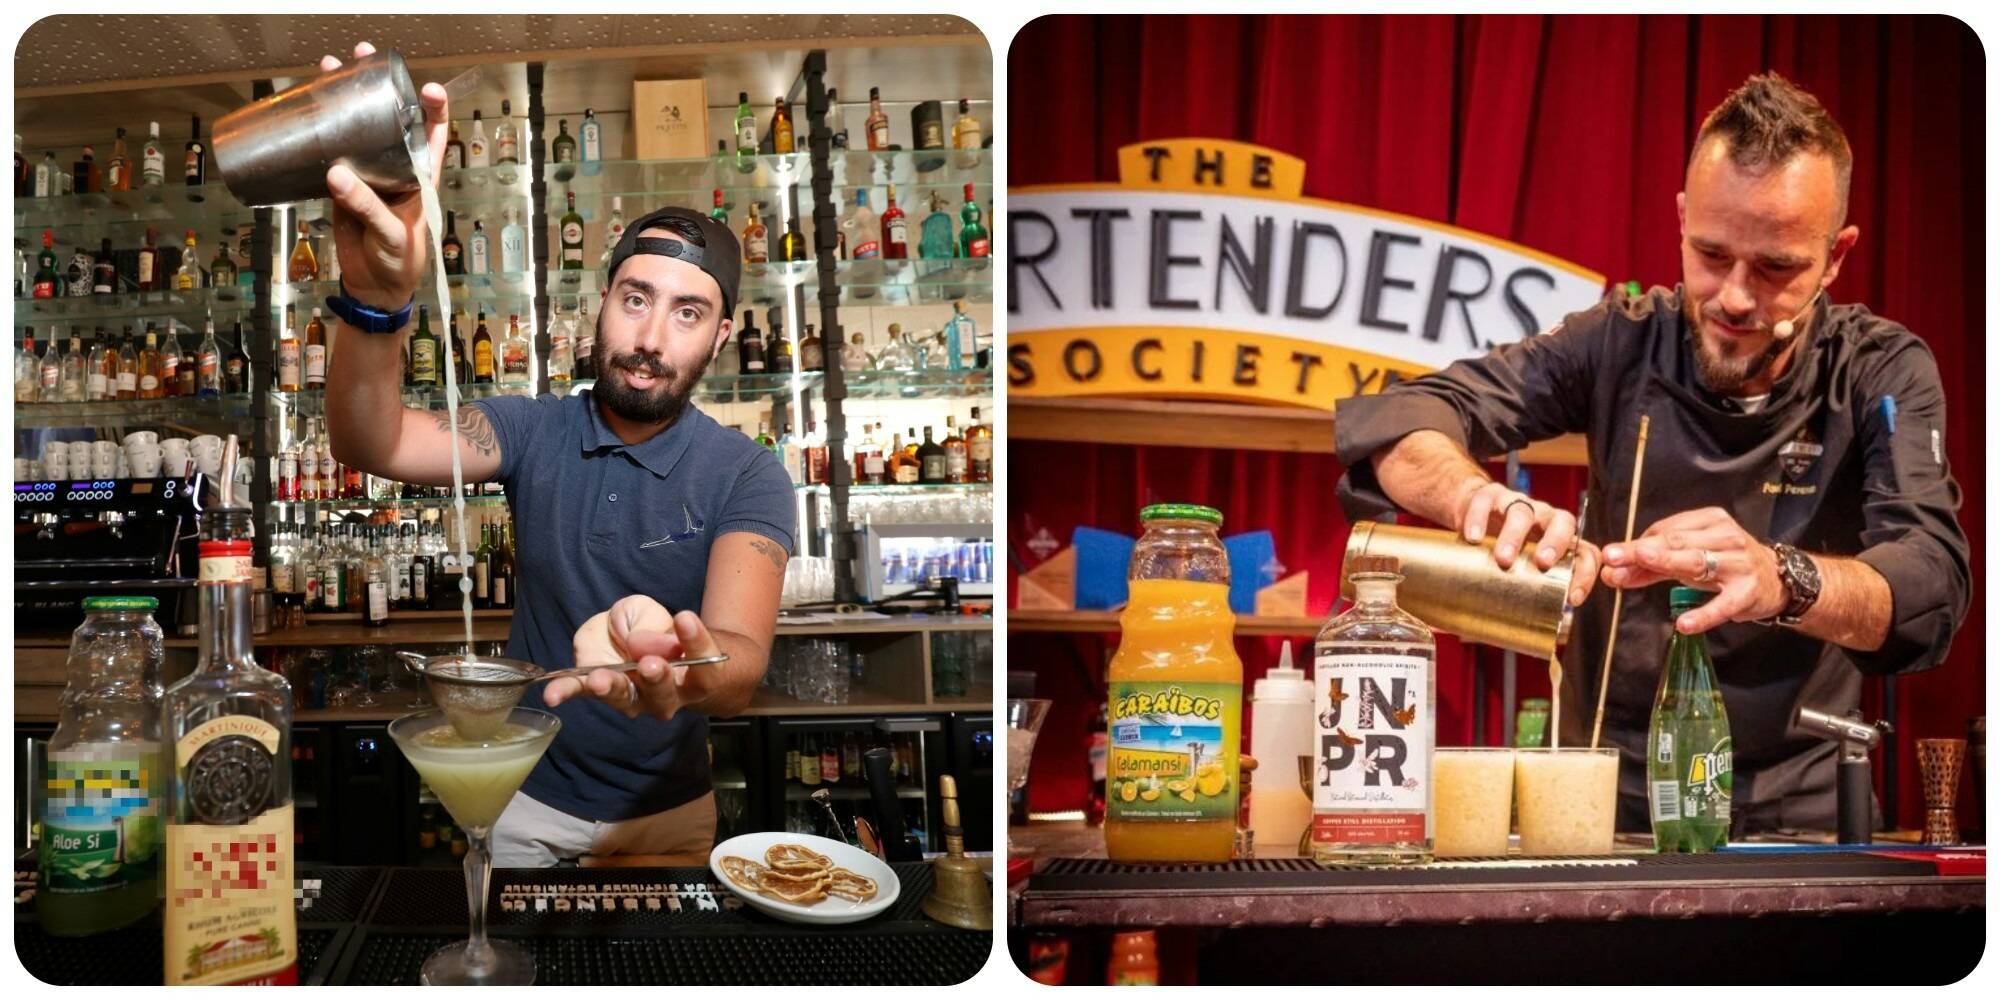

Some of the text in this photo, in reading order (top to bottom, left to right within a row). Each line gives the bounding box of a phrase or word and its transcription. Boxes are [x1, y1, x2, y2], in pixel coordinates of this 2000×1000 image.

[1143, 147, 1274, 188] THE
[1007, 208, 1556, 350] RTENDERS
[1008, 338, 1379, 396] SOCIETY
[1115, 686, 1221, 720] CARAÏBOS
[188, 721, 268, 746] MARTINIQUE
[1116, 754, 1182, 771] Calamansi
[1320, 734, 1408, 787] PR
[52, 833, 101, 850] Aloe Si
